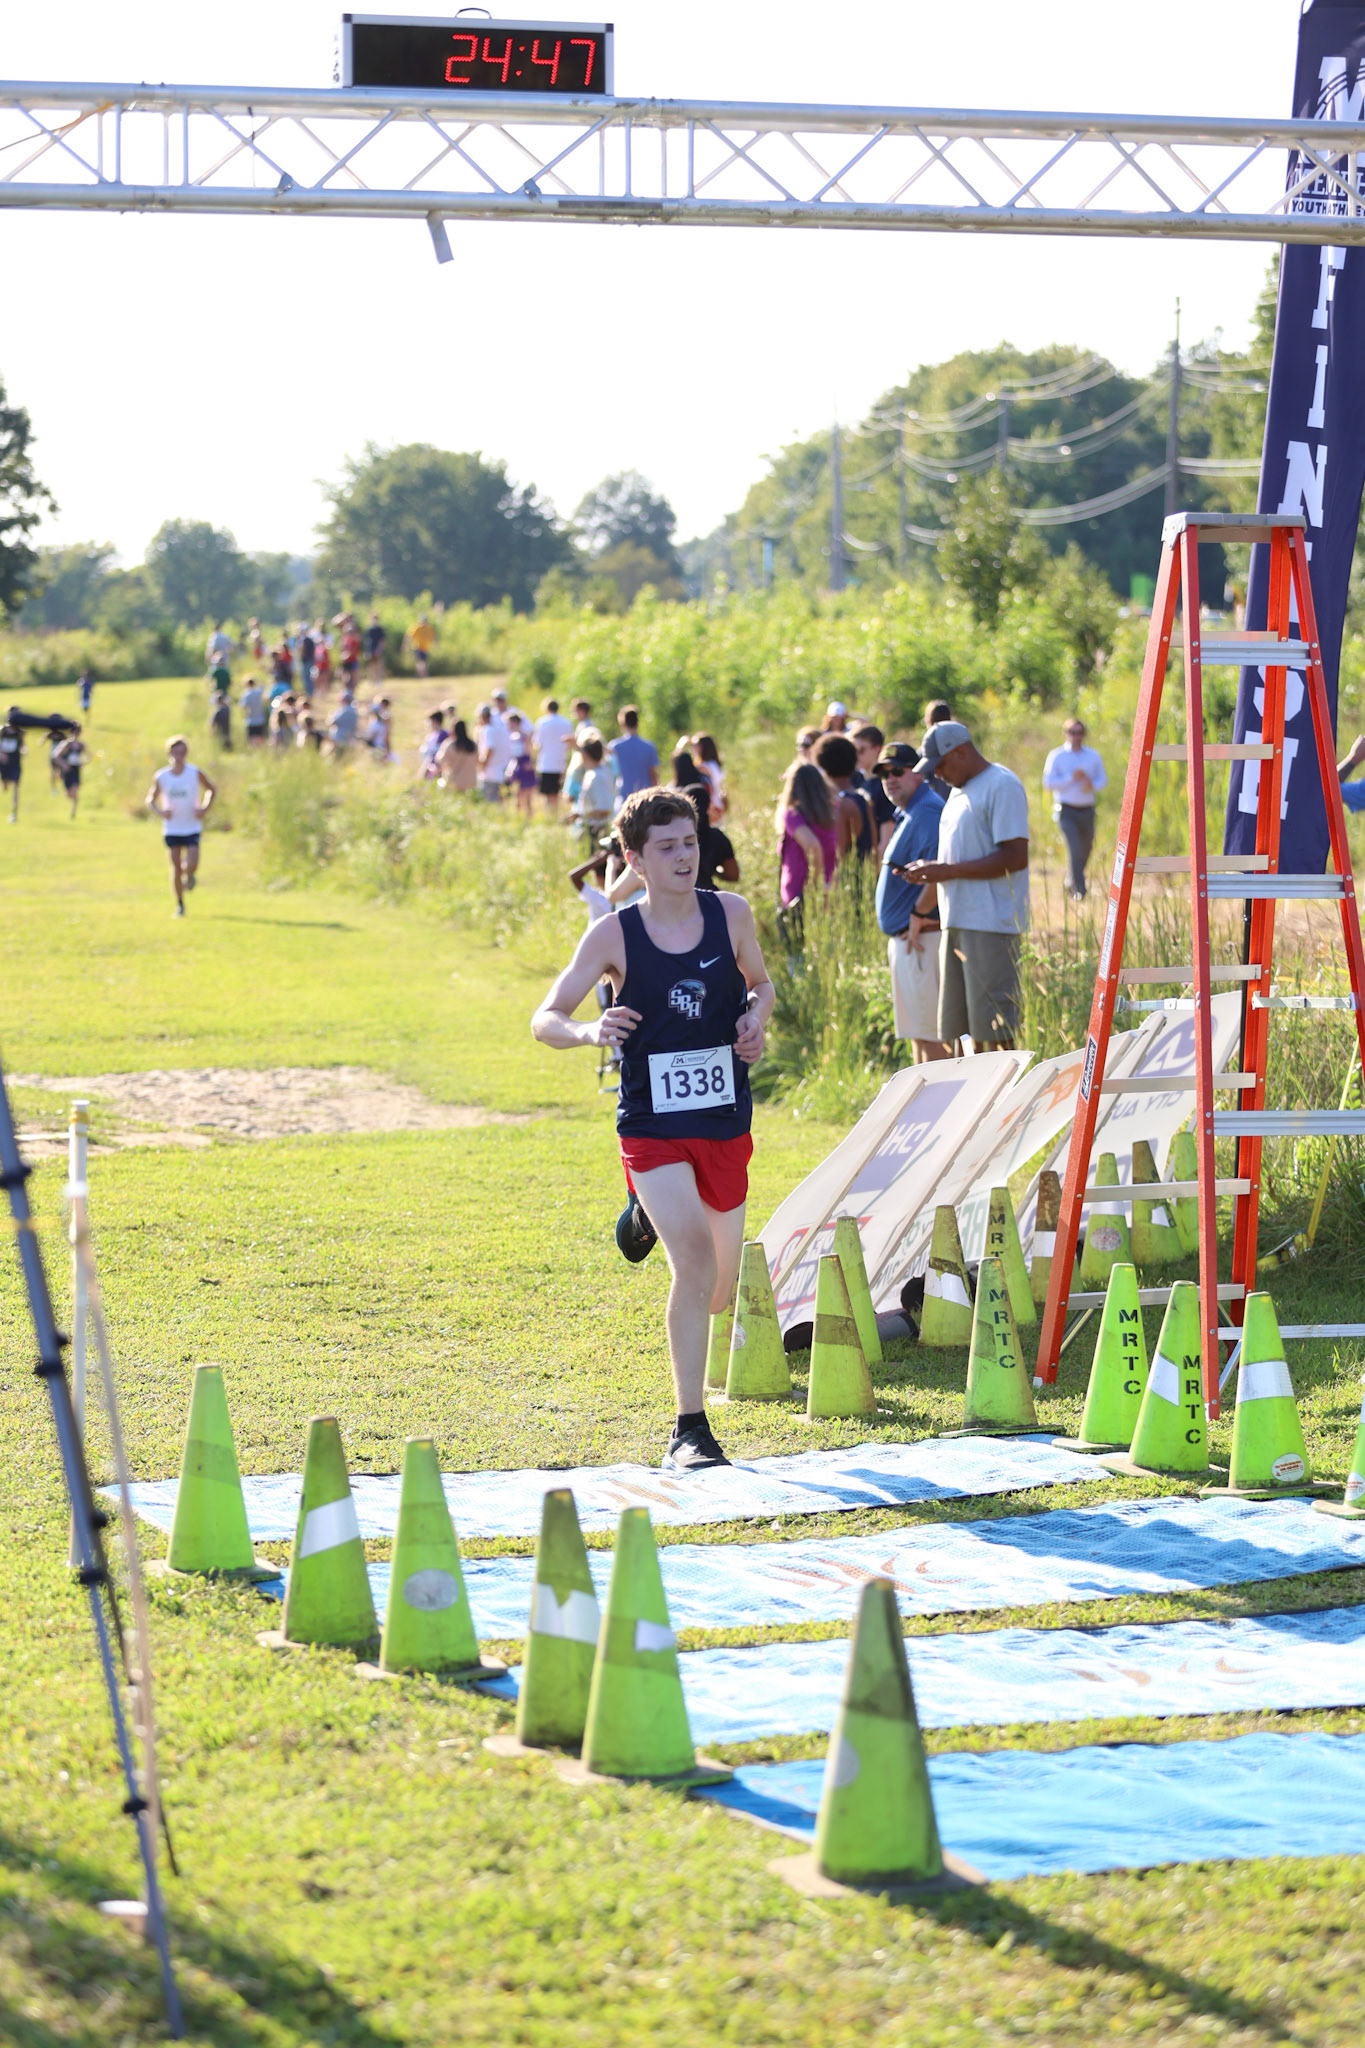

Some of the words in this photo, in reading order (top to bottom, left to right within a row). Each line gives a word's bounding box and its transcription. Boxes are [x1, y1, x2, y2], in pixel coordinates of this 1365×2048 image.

[445, 34, 597, 86] 24:47
[671, 989, 700, 1018] SBA
[661, 1065, 725, 1099] 1338
[989, 1213, 1006, 1258] MRT
[989, 1288, 1016, 1369] MRTC
[1118, 1309, 1141, 1394] MRTC
[1183, 1355, 1201, 1444] MRTC
